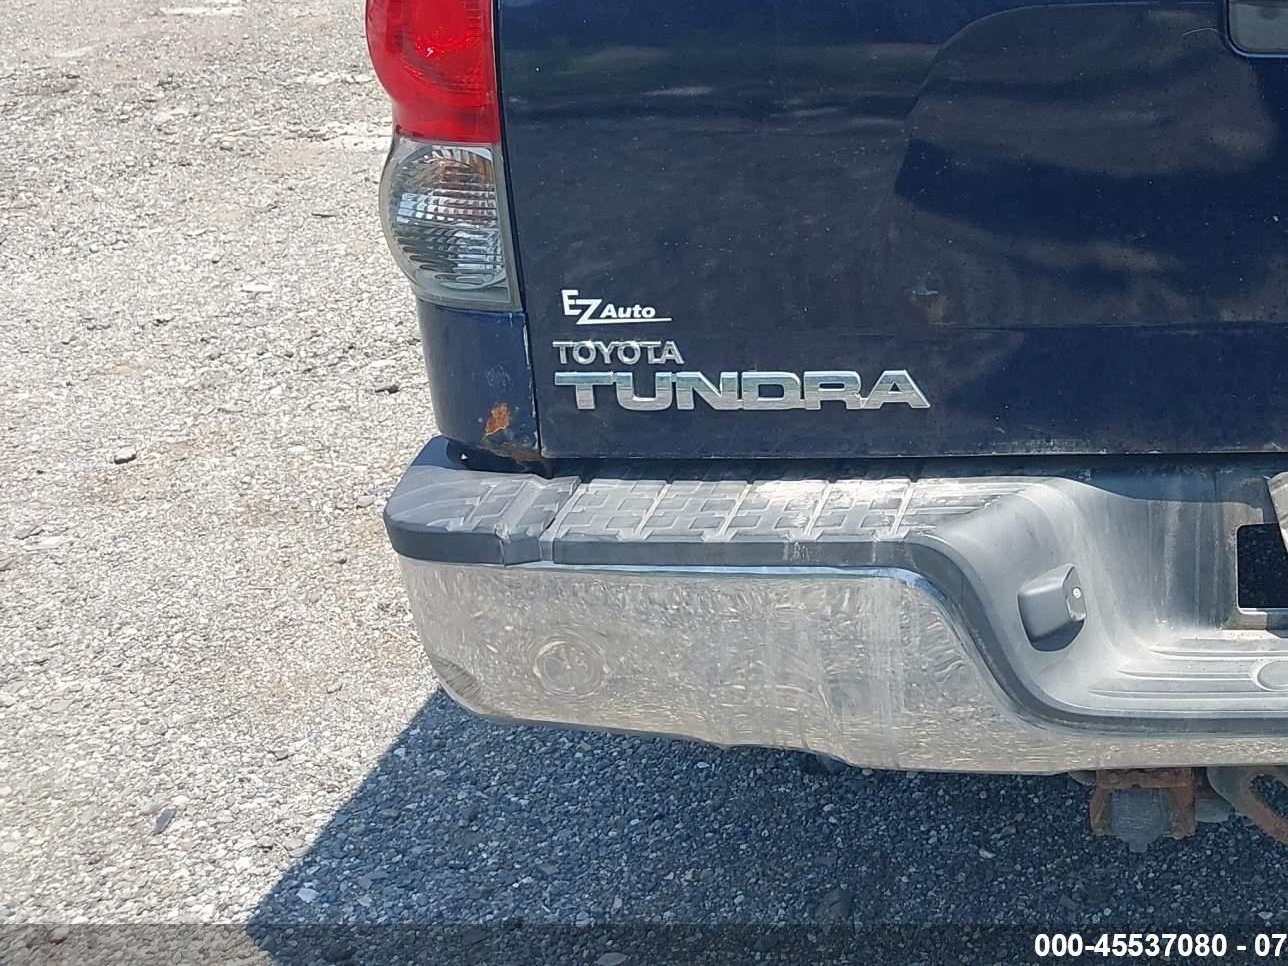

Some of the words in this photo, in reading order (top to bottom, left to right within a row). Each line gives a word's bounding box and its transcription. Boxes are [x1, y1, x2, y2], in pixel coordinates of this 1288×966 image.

[600, 304, 656, 318] Auto
[552, 340, 684, 364] TOYOTA
[554, 371, 930, 411] TUNDRA
